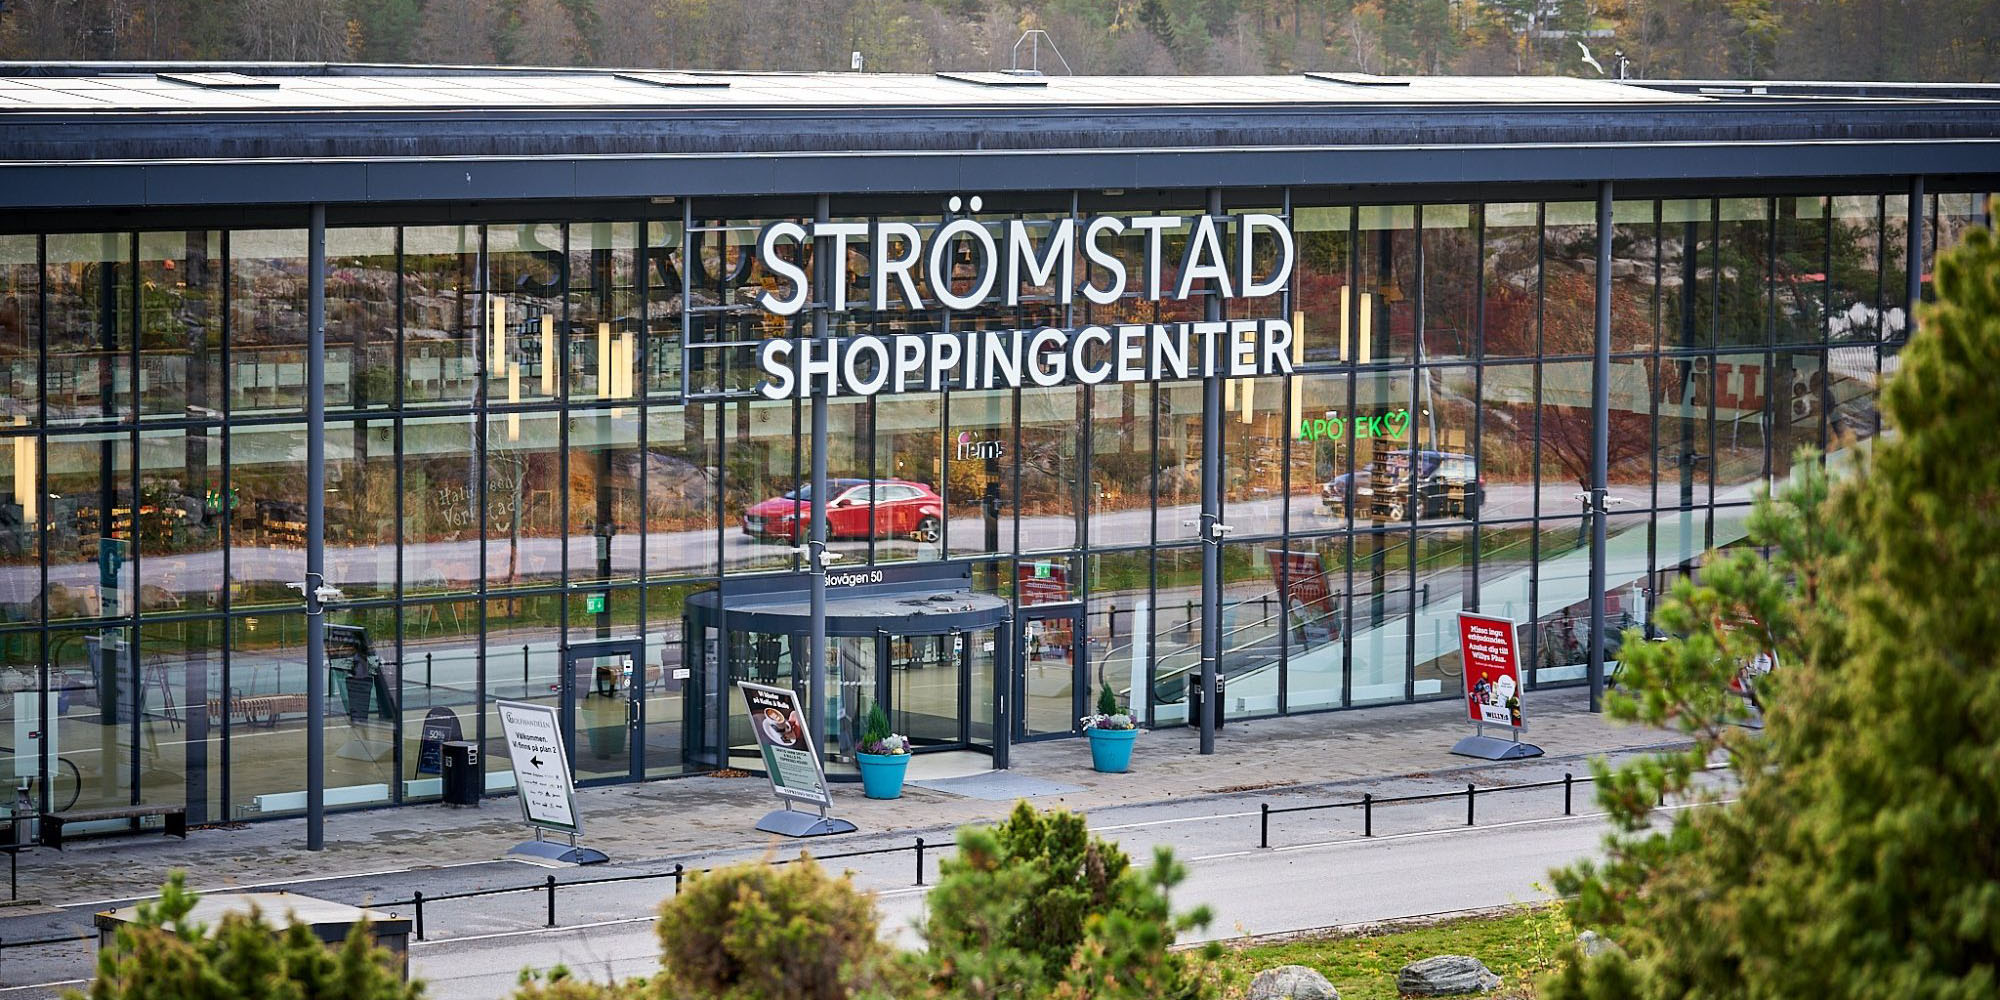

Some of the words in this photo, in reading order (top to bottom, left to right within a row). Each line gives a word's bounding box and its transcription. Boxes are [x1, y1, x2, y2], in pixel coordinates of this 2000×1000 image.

[756, 196, 1294, 316] STRÖMSTAD
[756, 319, 1294, 400] SHOPPINGCENTER
[1297, 416, 1382, 441] APOEK
[824, 570, 869, 587] slovägen
[870, 570, 883, 583] 50
[540, 745, 552, 754] plan
[552, 746, 558, 754] 2
